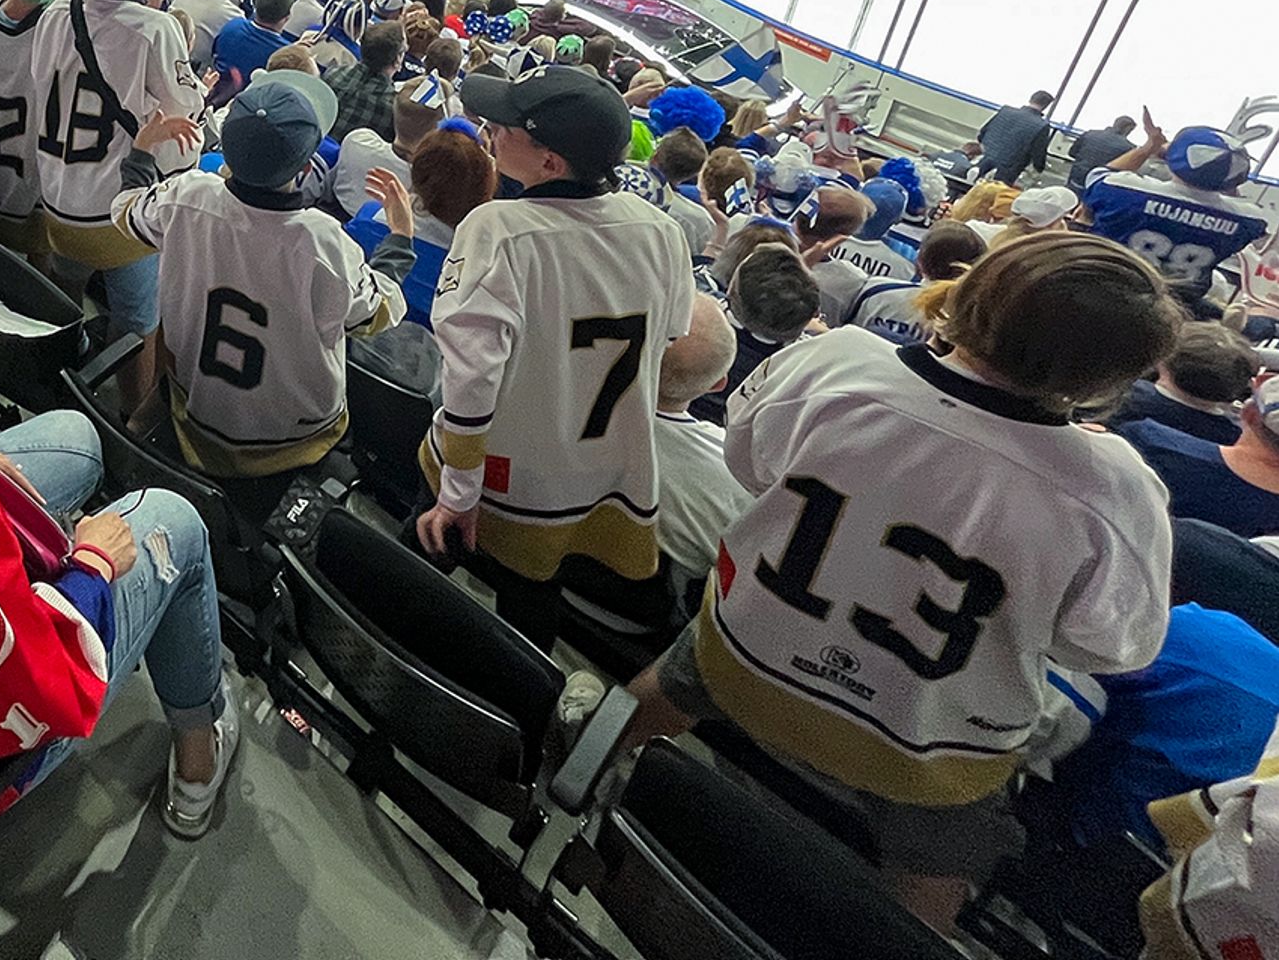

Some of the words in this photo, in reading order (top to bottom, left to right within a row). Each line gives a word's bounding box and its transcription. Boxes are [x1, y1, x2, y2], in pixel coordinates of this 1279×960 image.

[1144, 200, 1239, 235] KUJANSUU
[199, 287, 268, 390] 6
[570, 311, 648, 442] 7
[286, 498, 310, 523] FILA
[754, 473, 1007, 681] 13
